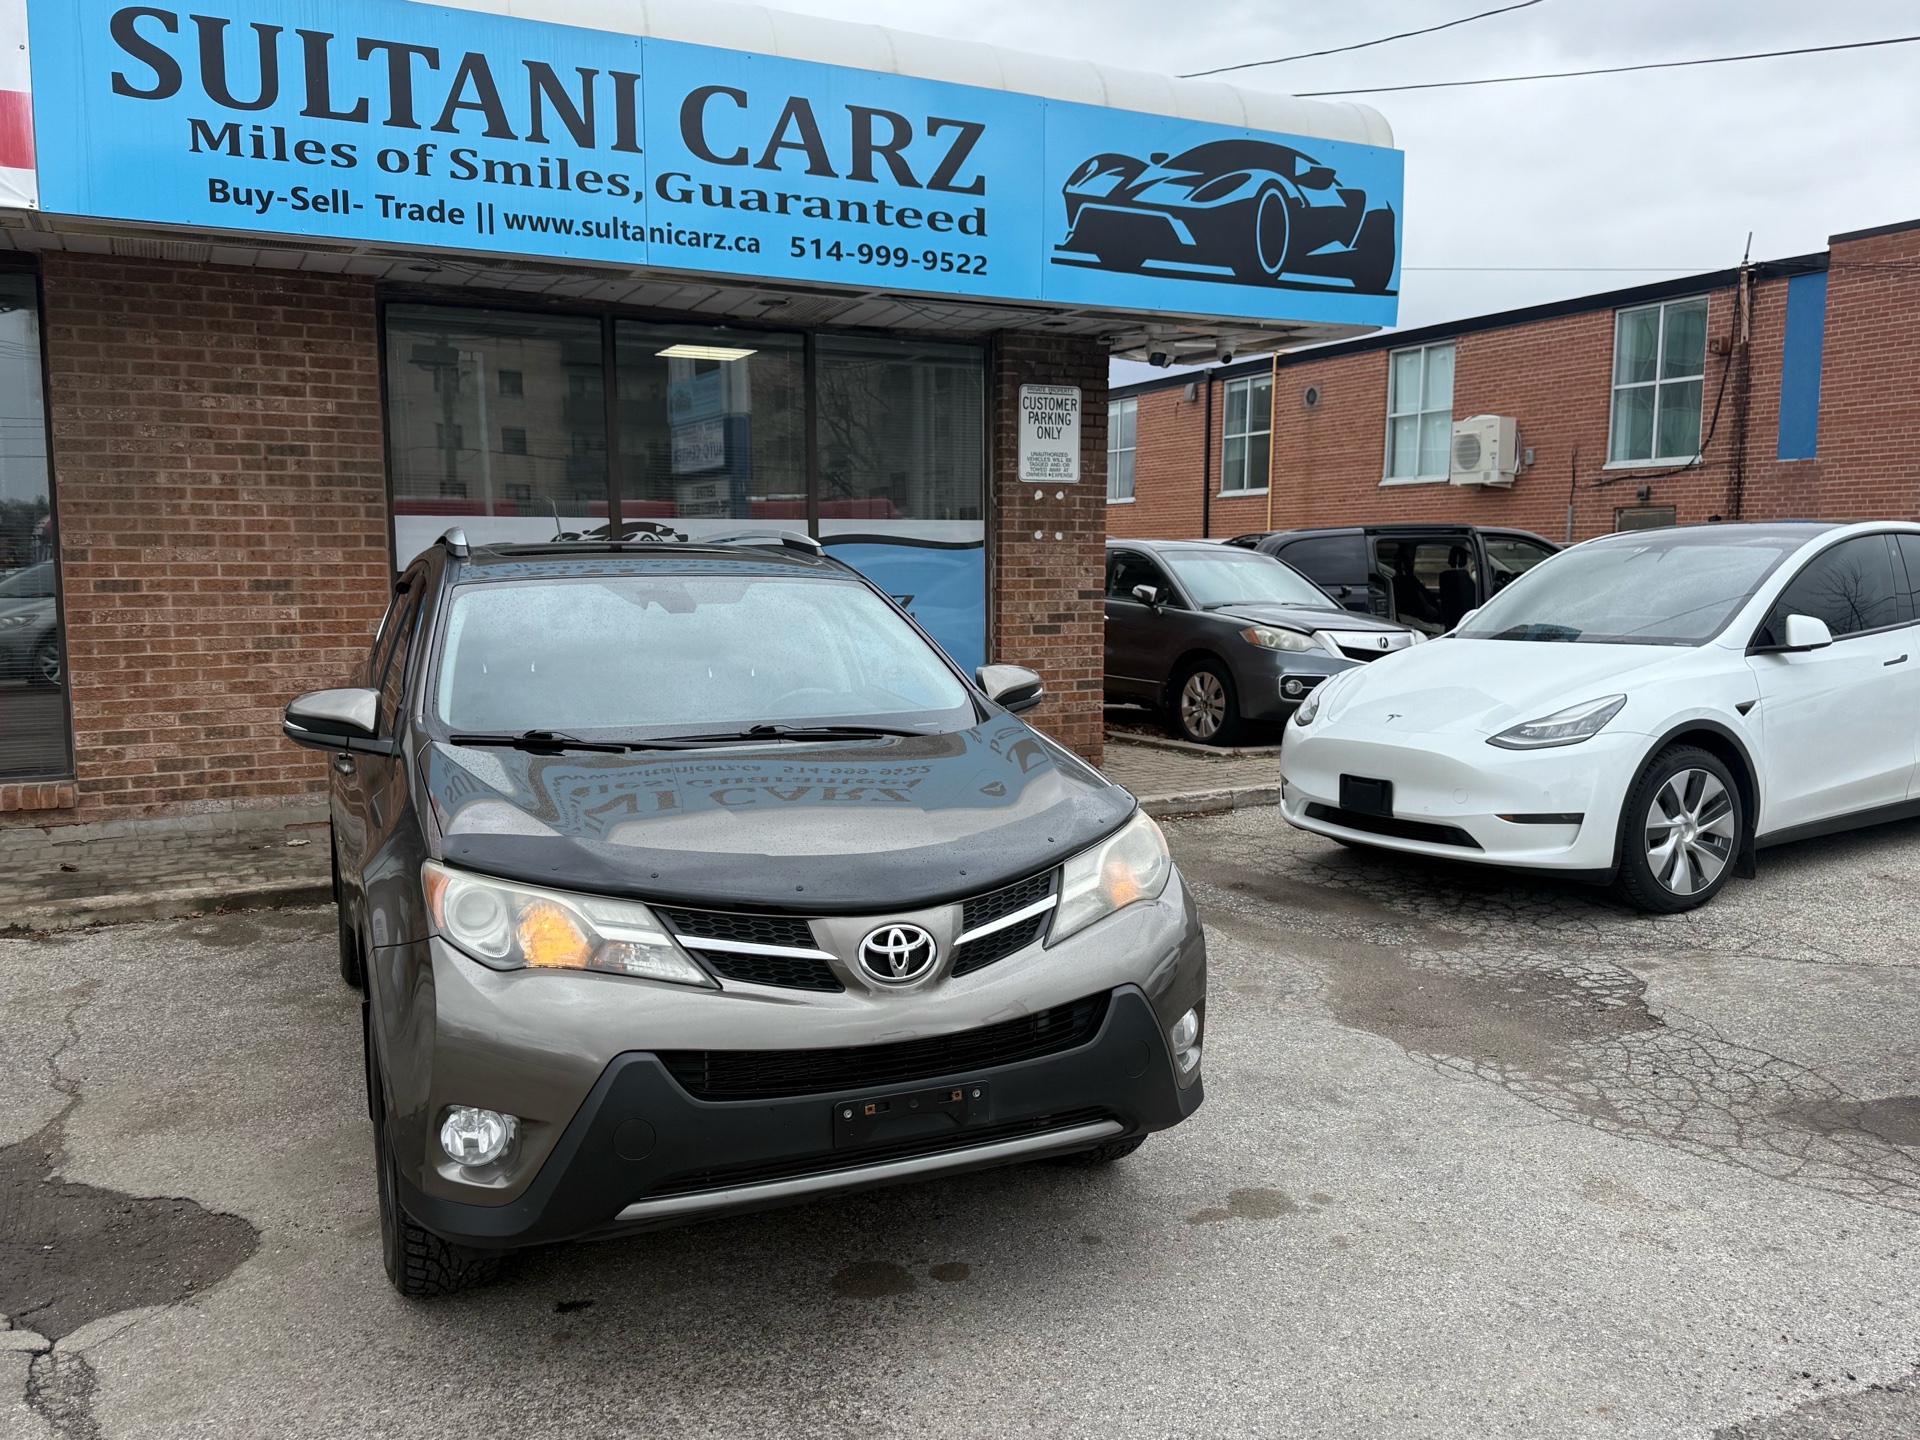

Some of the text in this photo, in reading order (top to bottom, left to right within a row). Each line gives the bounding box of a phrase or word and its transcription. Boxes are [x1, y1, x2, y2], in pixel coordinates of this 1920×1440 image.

[110, 6, 986, 196] SULTANI CARZ
[187, 118, 358, 168] Miles
[375, 143, 438, 177] of
[655, 172, 987, 238] Guaranteed
[208, 178, 364, 215] Buy-Sell-
[375, 194, 465, 226] Trade
[503, 212, 761, 255] www.sultanicarz.ca
[790, 236, 987, 276] 514-999-9522
[1023, 396, 1077, 411] CUSTOMER
[1028, 411, 1071, 426] PARKING
[1037, 425, 1062, 440] ONLY
